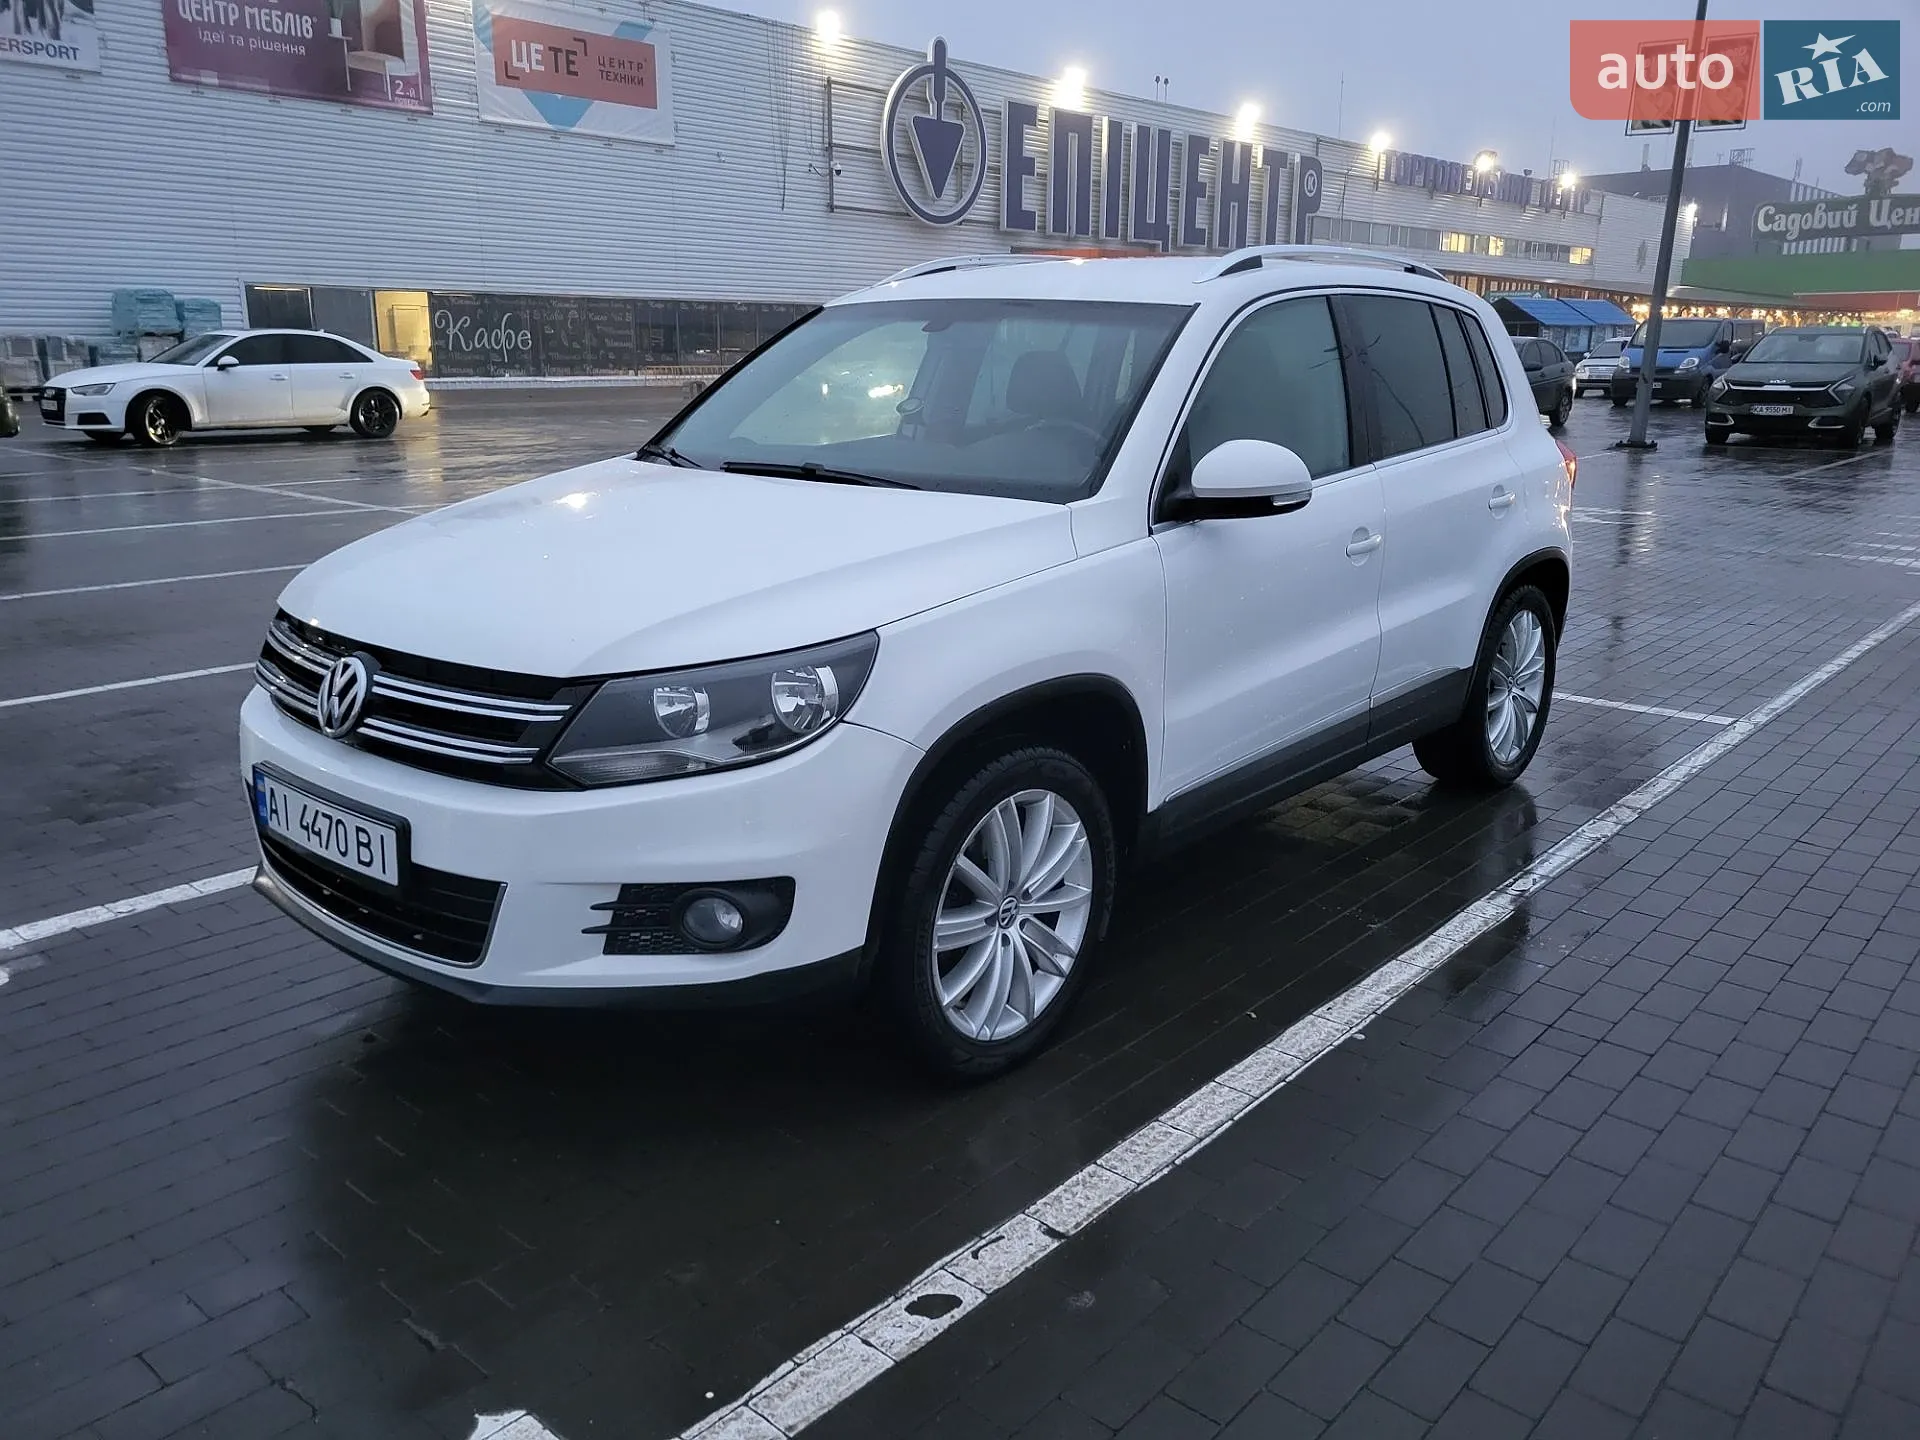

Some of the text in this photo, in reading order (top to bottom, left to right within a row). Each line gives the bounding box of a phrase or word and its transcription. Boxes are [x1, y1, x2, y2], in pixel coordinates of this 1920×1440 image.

[178, 0, 240, 26] ЦЕНТР
[229, 34, 244, 47] та
[249, 36, 306, 56] рішення
[597, 55, 644, 72] ЦЕНТР
[599, 69, 644, 87] ТЕХНІКИ
[1000, 100, 1323, 252] ЕПІЦЕНТР
[1757, 202, 1859, 241] Садовий
[434, 309, 532, 363] Кафе
[269, 787, 387, 875] AI 4470 BI
